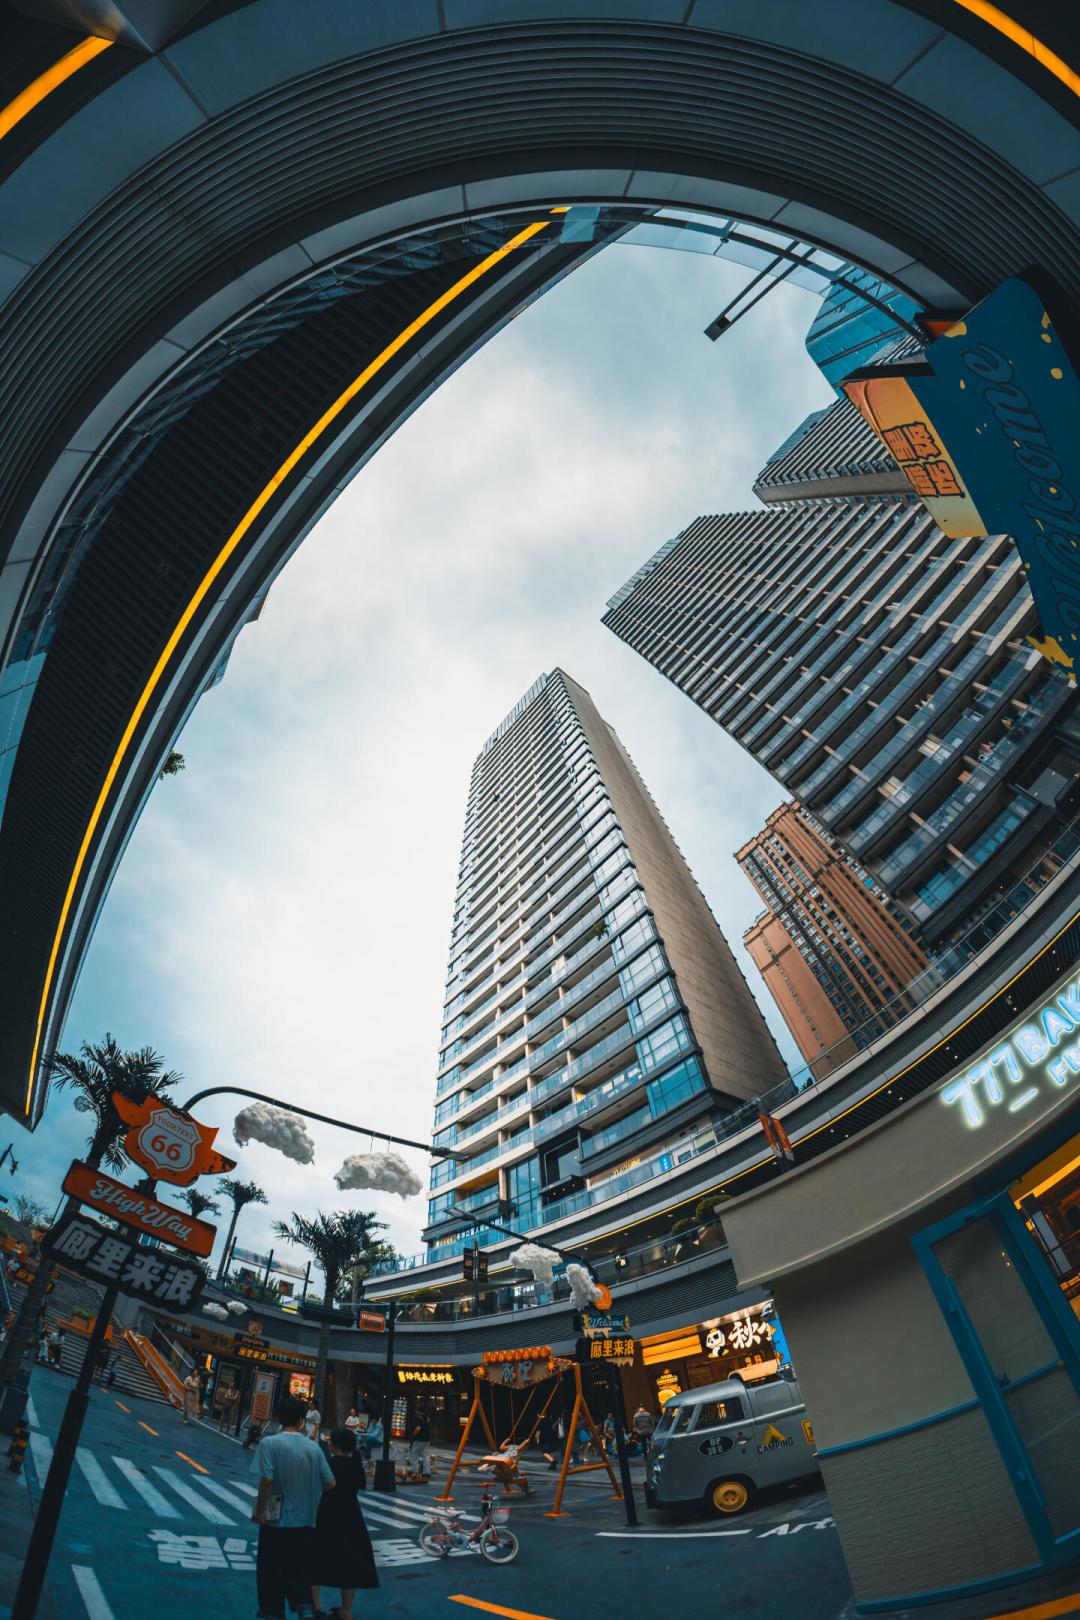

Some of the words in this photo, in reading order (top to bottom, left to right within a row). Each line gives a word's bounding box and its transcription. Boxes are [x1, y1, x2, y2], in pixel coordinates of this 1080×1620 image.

[150, 1134, 182, 1162] 66
[53, 1219, 199, 1306] 廊里来浪
[587, 1316, 624, 1329] Welcome
[590, 1339, 635, 1359] 廊里来浪
[757, 1437, 794, 1455] CAMPING
